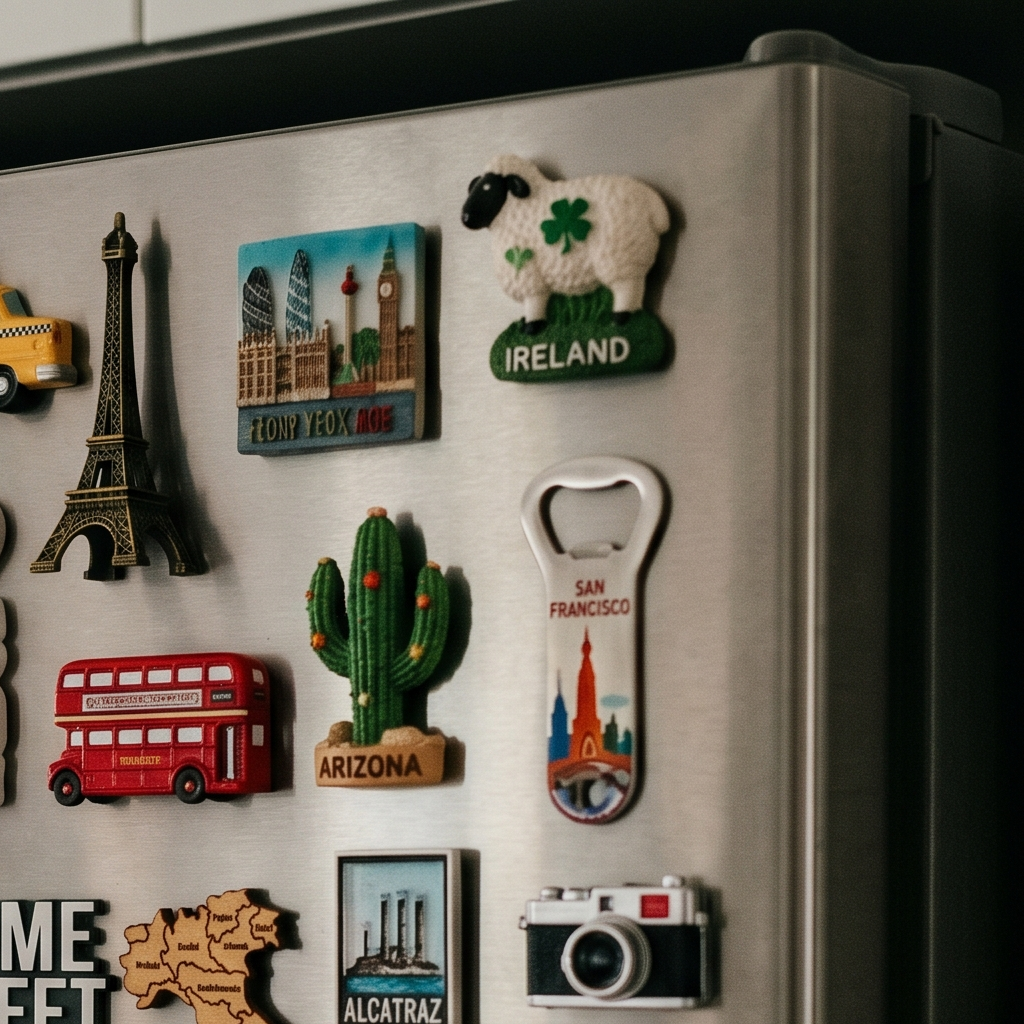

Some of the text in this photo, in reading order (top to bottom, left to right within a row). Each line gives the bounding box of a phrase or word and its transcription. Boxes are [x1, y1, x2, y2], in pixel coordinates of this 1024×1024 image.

[505, 336, 630, 373] IRELAND
[575, 579, 604, 597] SAN
[549, 598, 631, 619] FRANCISCO
[319, 753, 423, 779] ARIZONA
[343, 997, 442, 1024] ALCATRAZ
